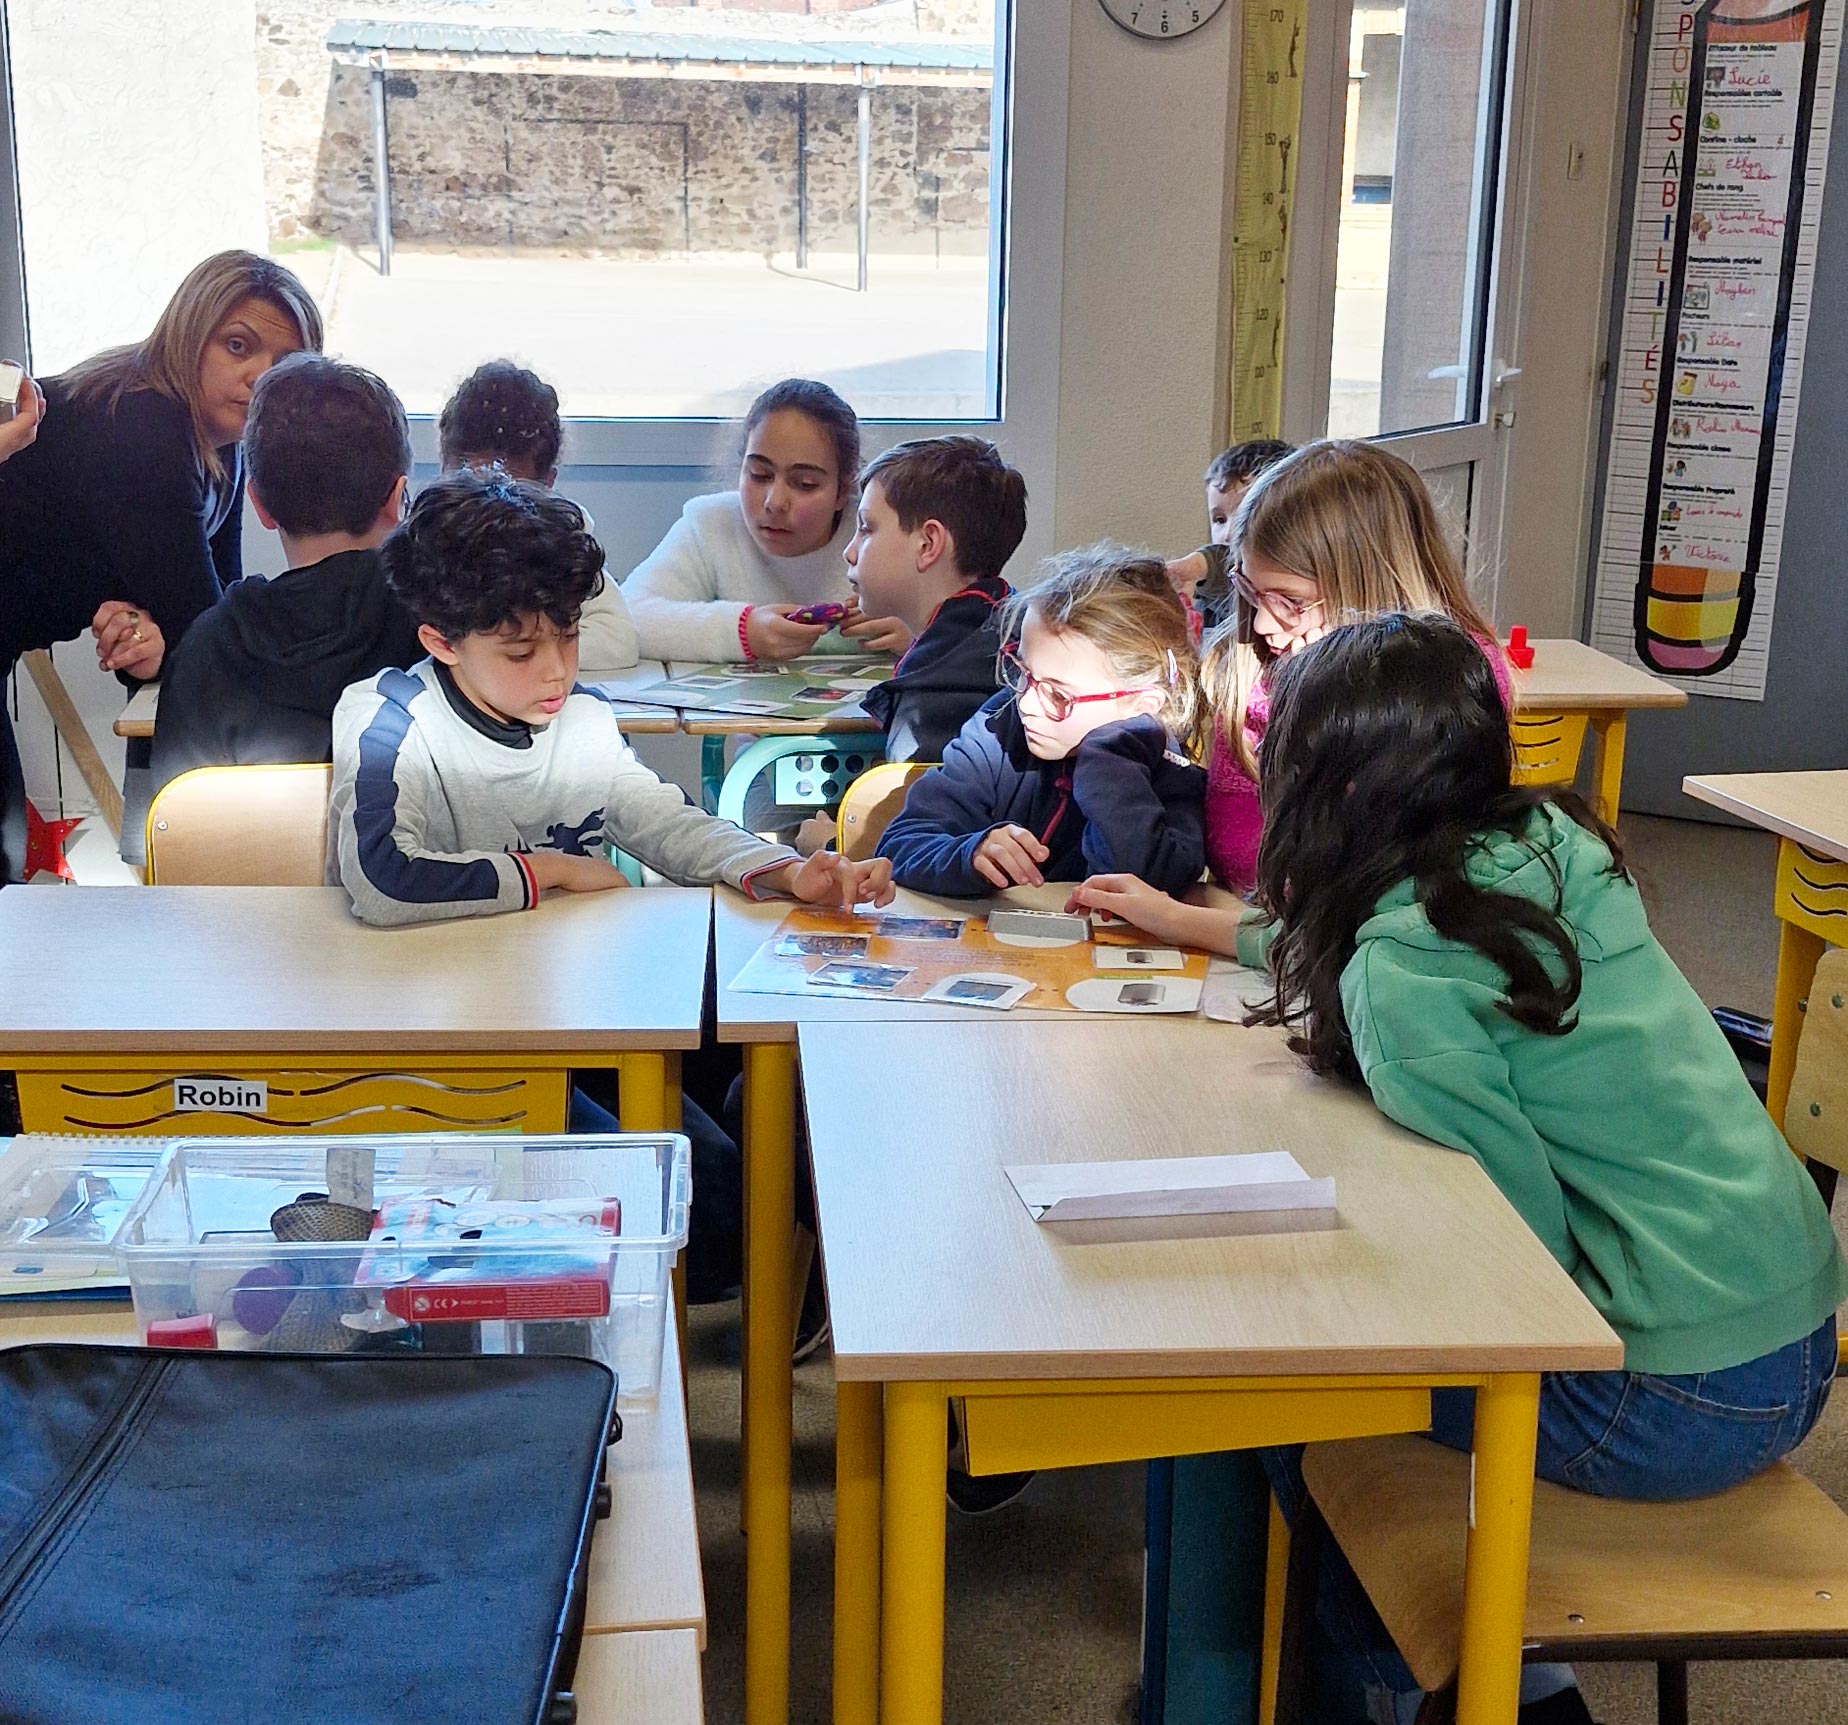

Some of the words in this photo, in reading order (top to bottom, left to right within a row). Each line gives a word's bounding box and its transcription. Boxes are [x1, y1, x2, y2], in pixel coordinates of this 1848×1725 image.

[1131, 12, 1138, 25] 7
[1192, 10, 1200, 23] 5
[1269, 10, 1284, 23] 170
[1160, 20, 1169, 33] 6
[1266, 72, 1279, 85] 160
[1728, 66, 1772, 86] Lucie
[1264, 132, 1277, 146] 150
[1733, 135, 1757, 144] cloche
[1696, 183, 1715, 191] Chefs
[1727, 185, 1744, 193] rang
[1262, 192, 1274, 205] 140
[1258, 250, 1273, 263] 130
[1688, 256, 1731, 264] Responsable
[1256, 308, 1269, 321] 120
[1677, 356, 1720, 365] Responsable
[1251, 422, 1263, 434] 100
[1667, 442, 1709, 451] Responsable
[1663, 483, 1705, 492] Responsable
[178, 1084, 261, 1107] Robin
